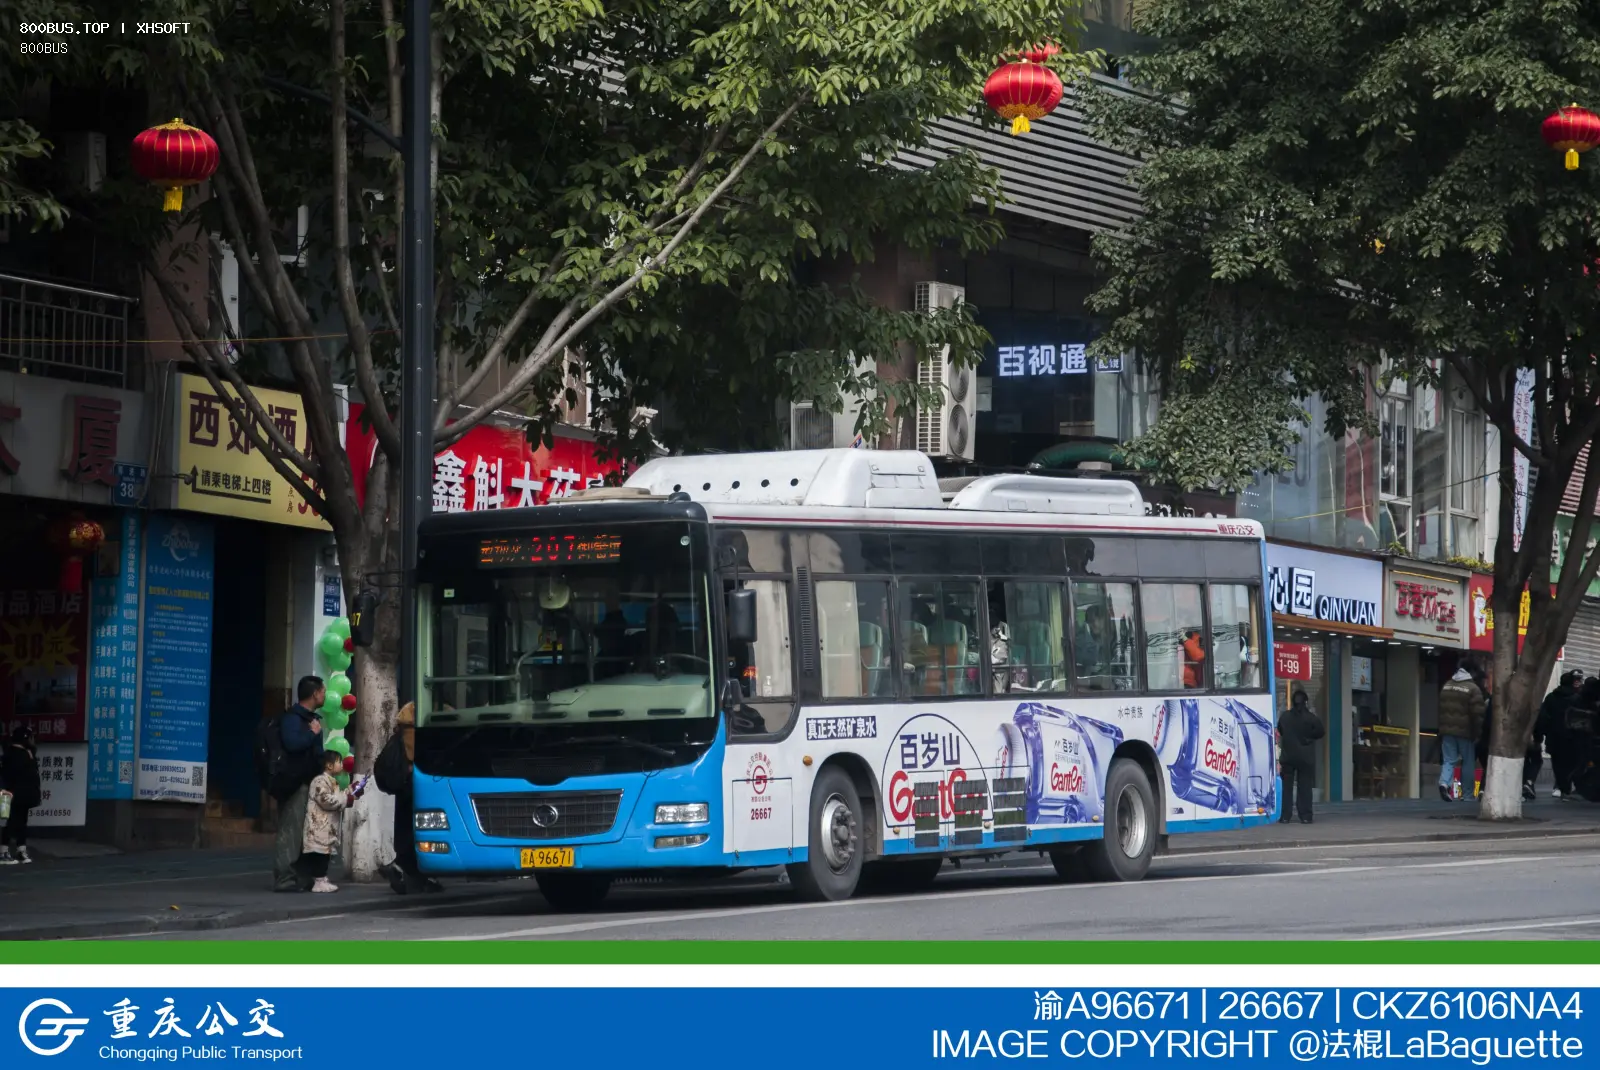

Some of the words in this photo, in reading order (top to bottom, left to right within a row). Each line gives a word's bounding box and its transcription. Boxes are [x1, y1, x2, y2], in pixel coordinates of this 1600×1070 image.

[998, 343, 1088, 377] 百视通
[189, 391, 313, 466] 西郊酒
[201, 469, 272, 496] 请乘电梯上四楼
[433, 450, 605, 513] 鑫斛大药
[1217, 523, 1256, 536] 重庆公交
[1318, 594, 1378, 627] QINYUAN
[1118, 705, 1144, 719] 水中贵族
[807, 716, 877, 740] 真正天然矿泉水
[900, 732, 961, 770] 百岁山
[750, 807, 772, 820] 26667
